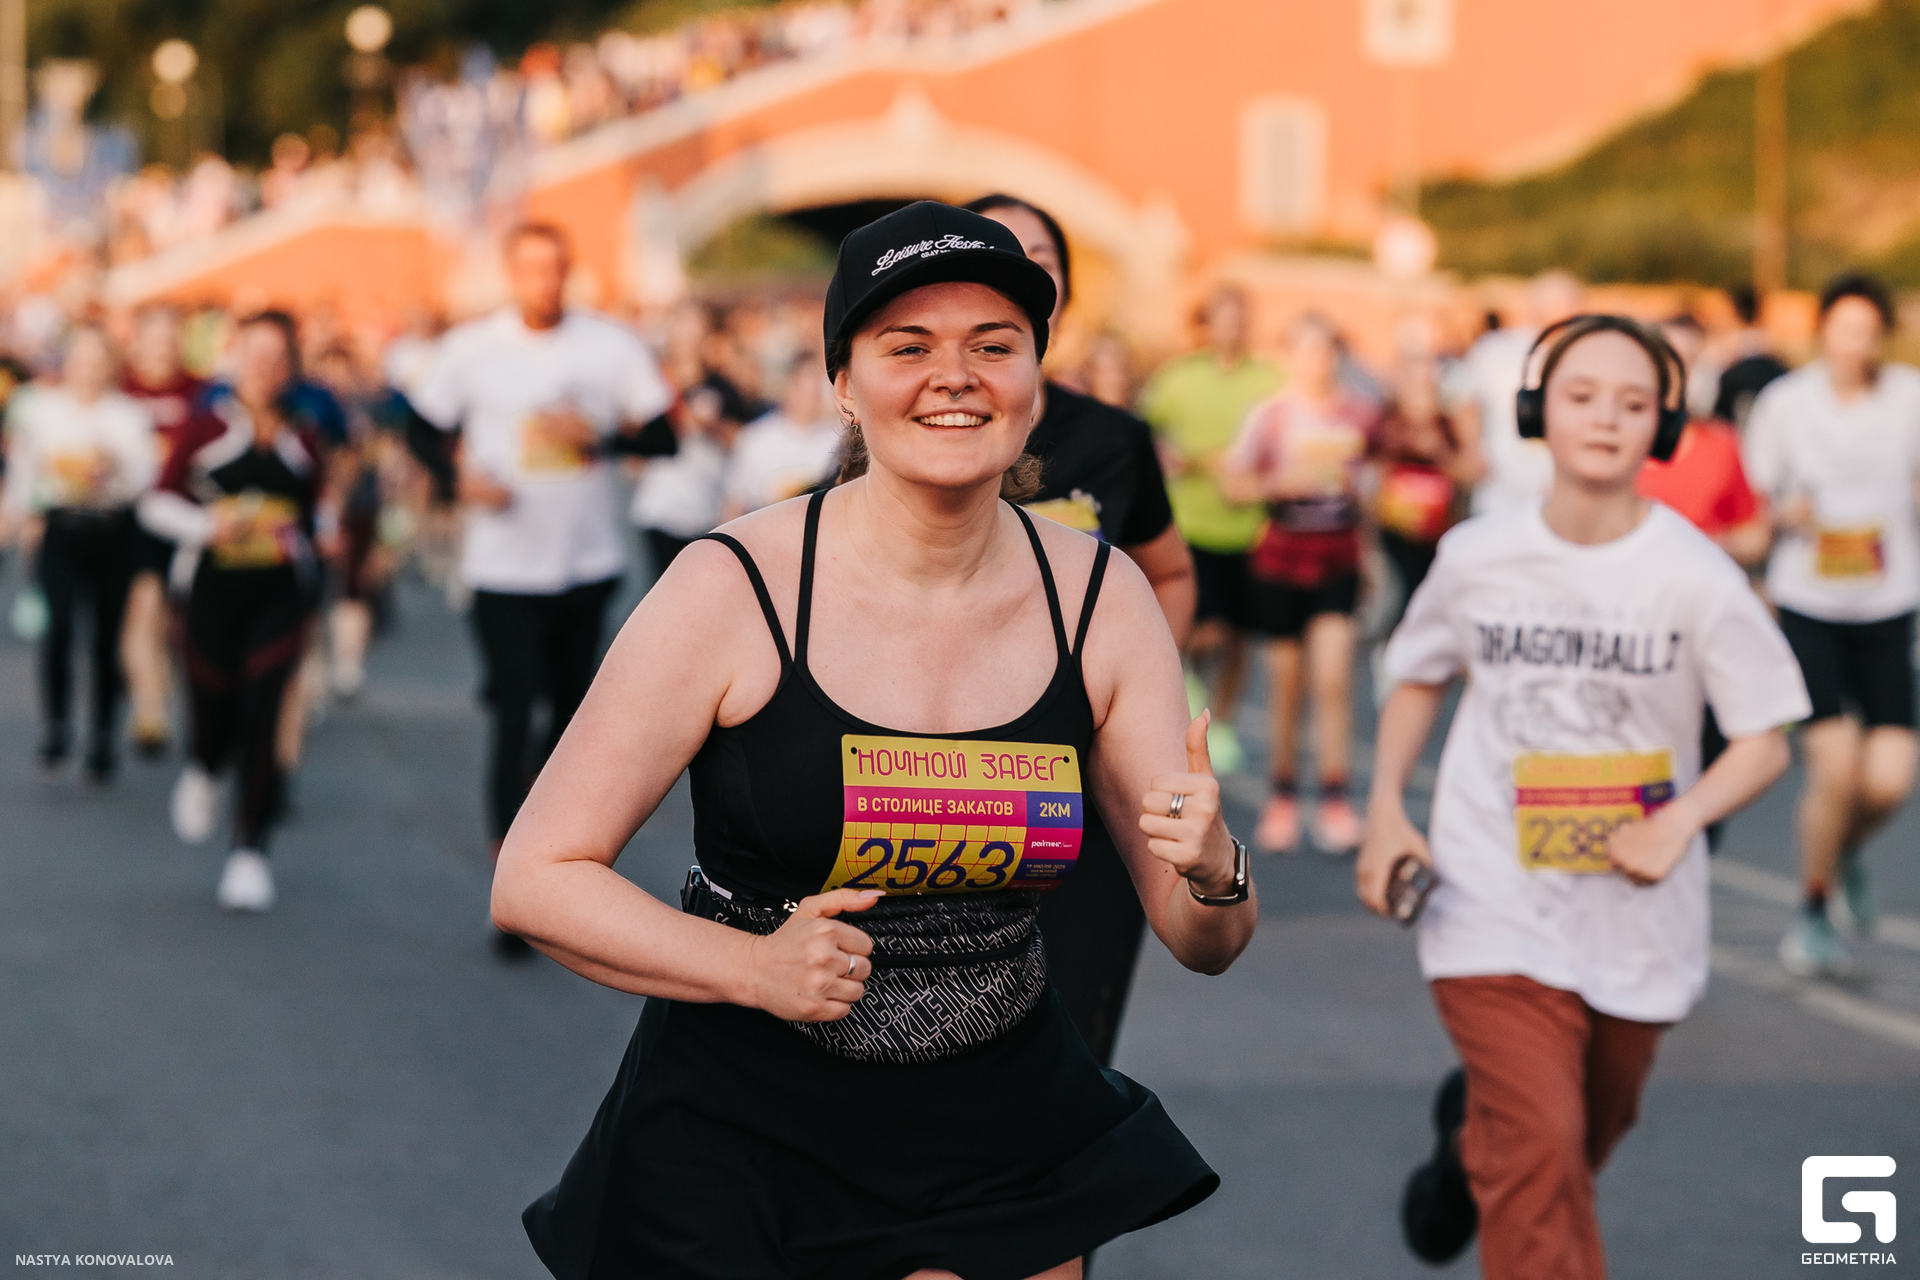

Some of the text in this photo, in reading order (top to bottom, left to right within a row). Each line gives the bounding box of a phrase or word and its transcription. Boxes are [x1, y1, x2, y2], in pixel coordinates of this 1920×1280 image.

[871, 240, 934, 276] Leisure
[857, 748, 1064, 782] НОЧНОЙ ЗАБЕГ
[857, 797, 1014, 816] В СТОЛИЦЕ ЗАКАТОВ
[1039, 802, 1071, 818] 2КМ
[1528, 814, 1634, 863] 238
[841, 838, 1015, 889] 2563
[892, 968, 976, 1051] KLEIN
